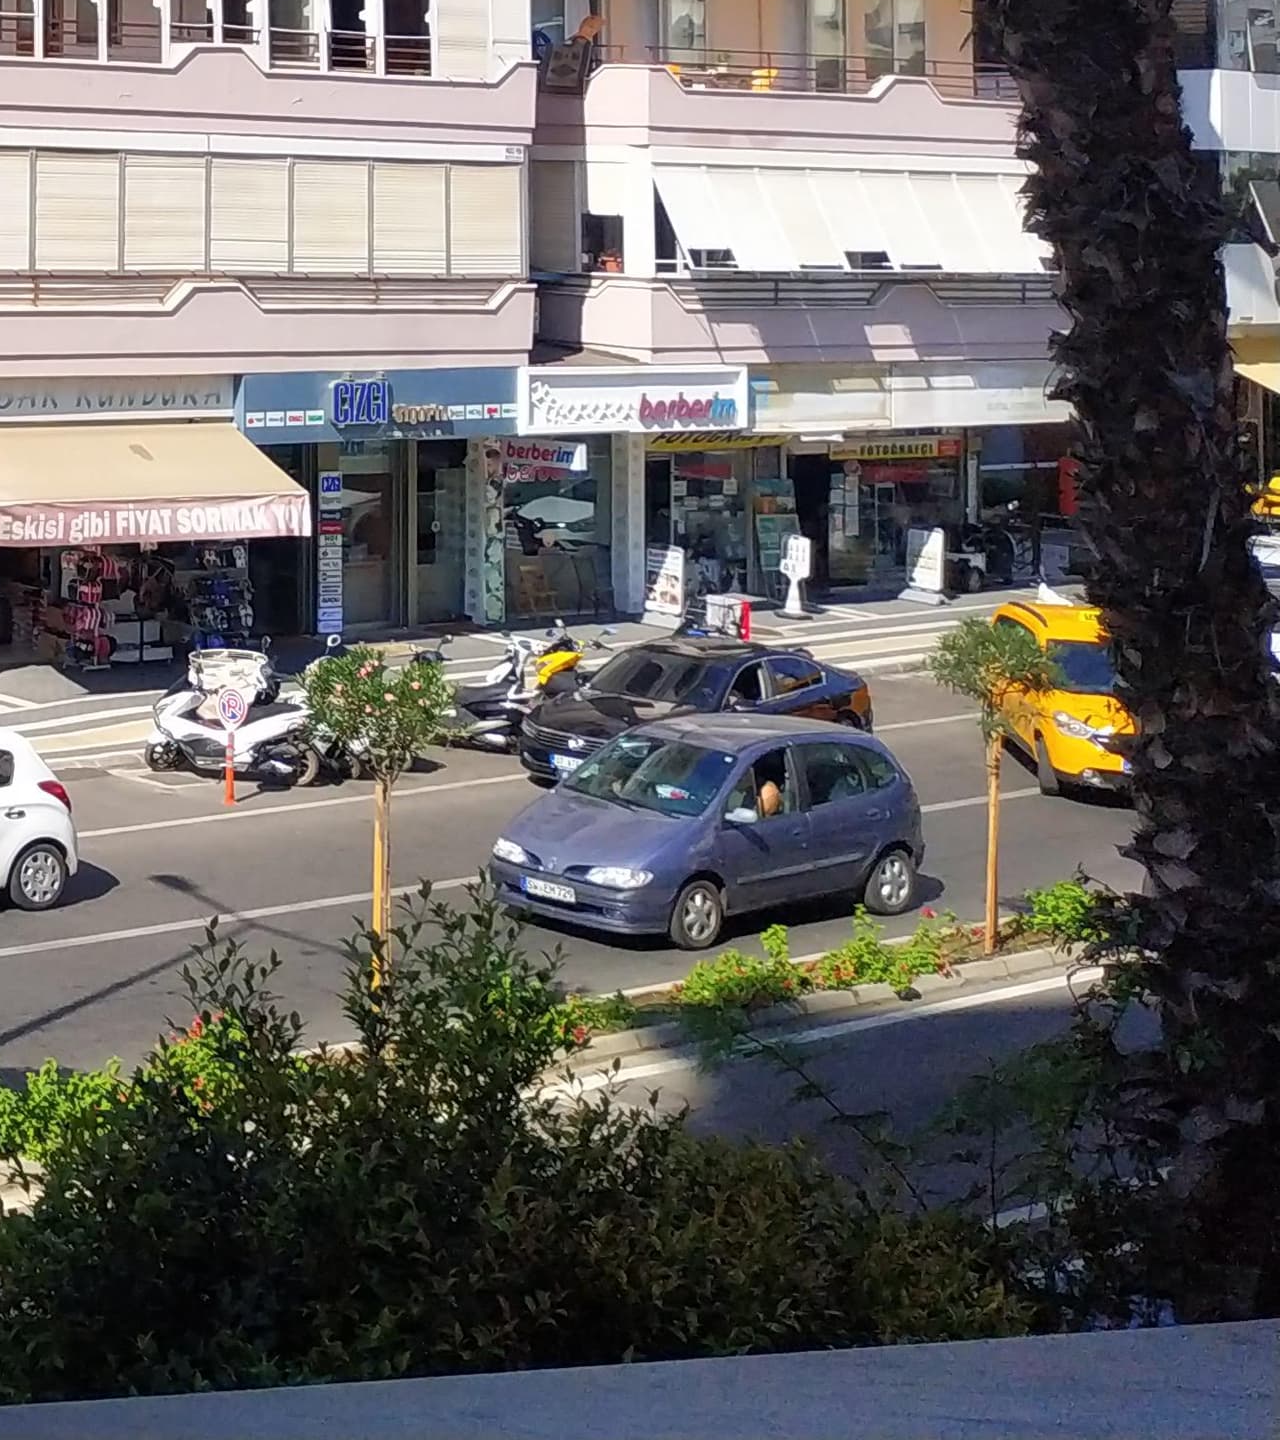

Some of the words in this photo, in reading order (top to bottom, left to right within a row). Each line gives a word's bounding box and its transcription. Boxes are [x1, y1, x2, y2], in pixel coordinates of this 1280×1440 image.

[639, 391, 738, 424] berberim
[506, 440, 575, 464] berberim
[67, 510, 111, 543] gibi
[116, 503, 172, 537] FİYAT
[175, 504, 273, 534] SORMAK
